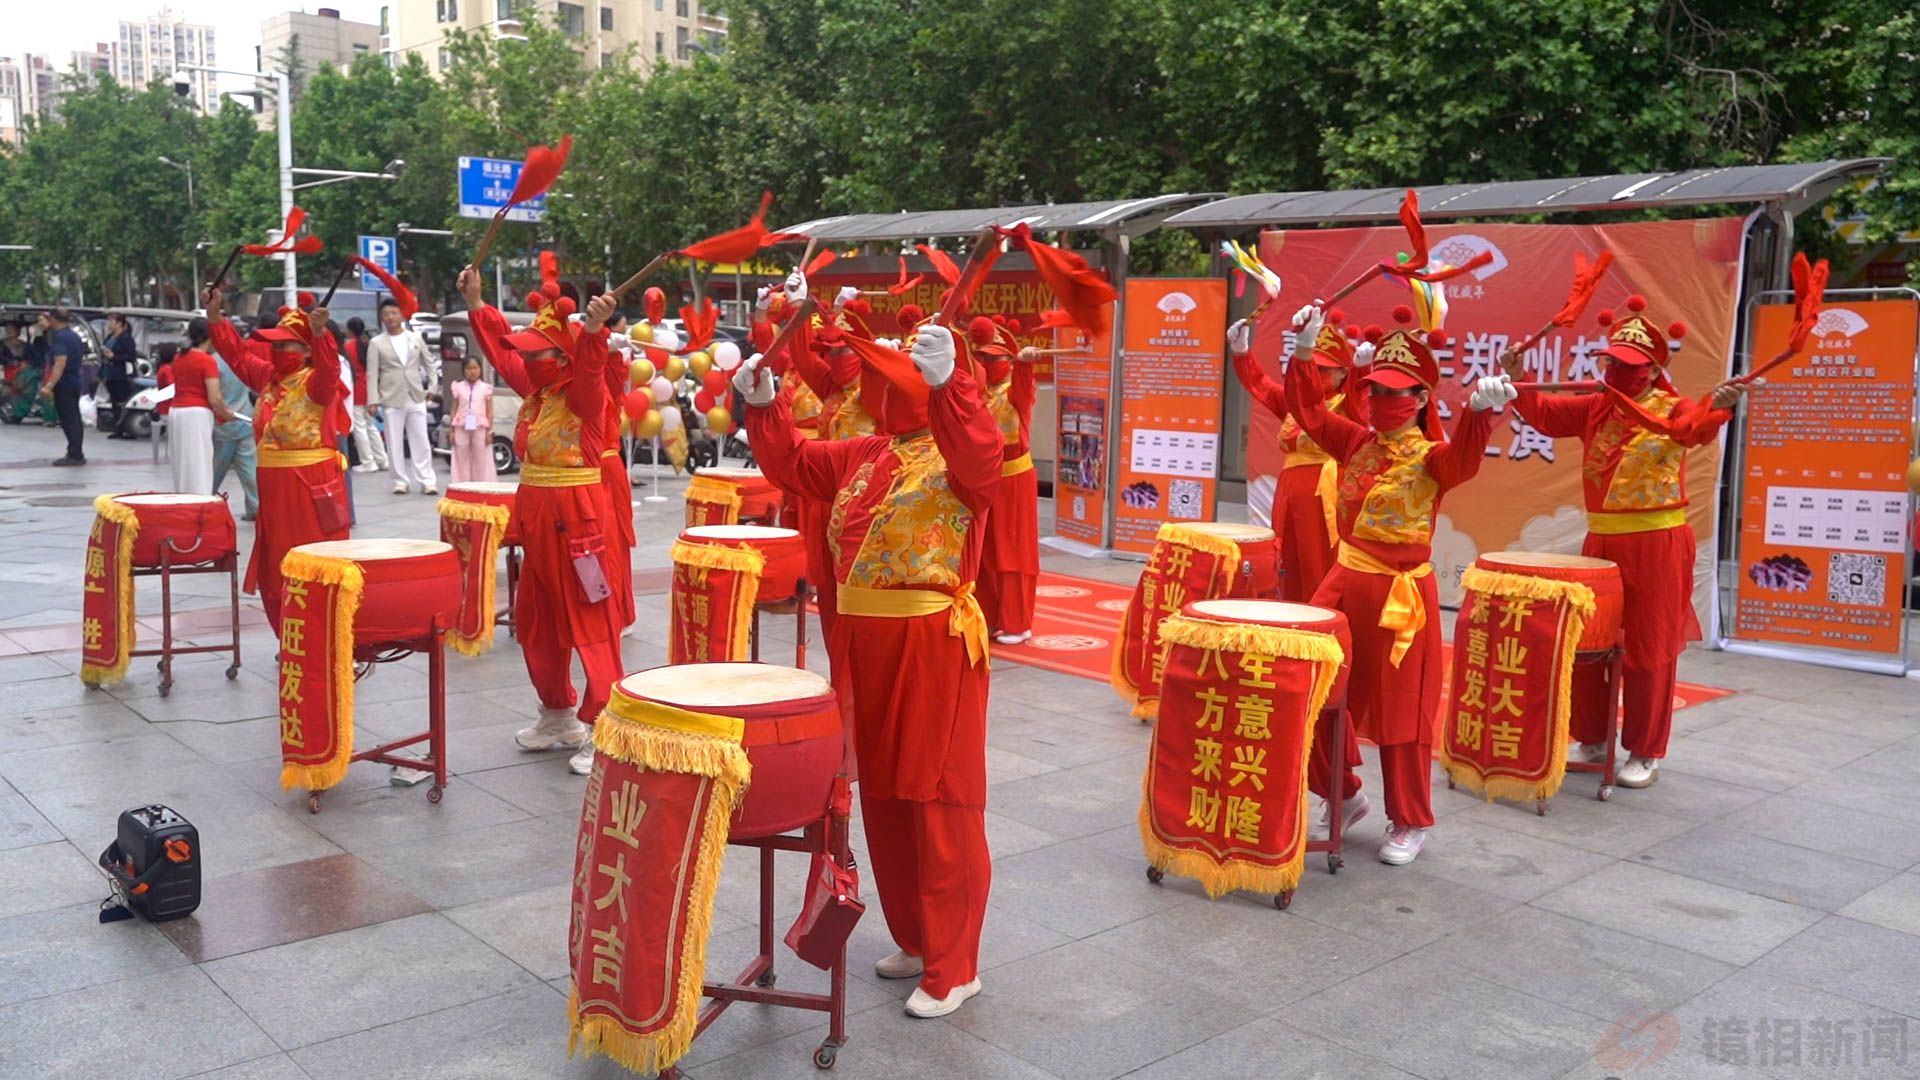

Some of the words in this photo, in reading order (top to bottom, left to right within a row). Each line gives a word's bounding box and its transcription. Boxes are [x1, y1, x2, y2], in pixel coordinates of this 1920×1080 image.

[369, 240, 389, 264] P
[1185, 650, 1229, 833] 八方来财
[1224, 652, 1276, 845] 生意兴隆
[1490, 597, 1533, 760] 开业大吉
[591, 764, 648, 994] 业大吉
